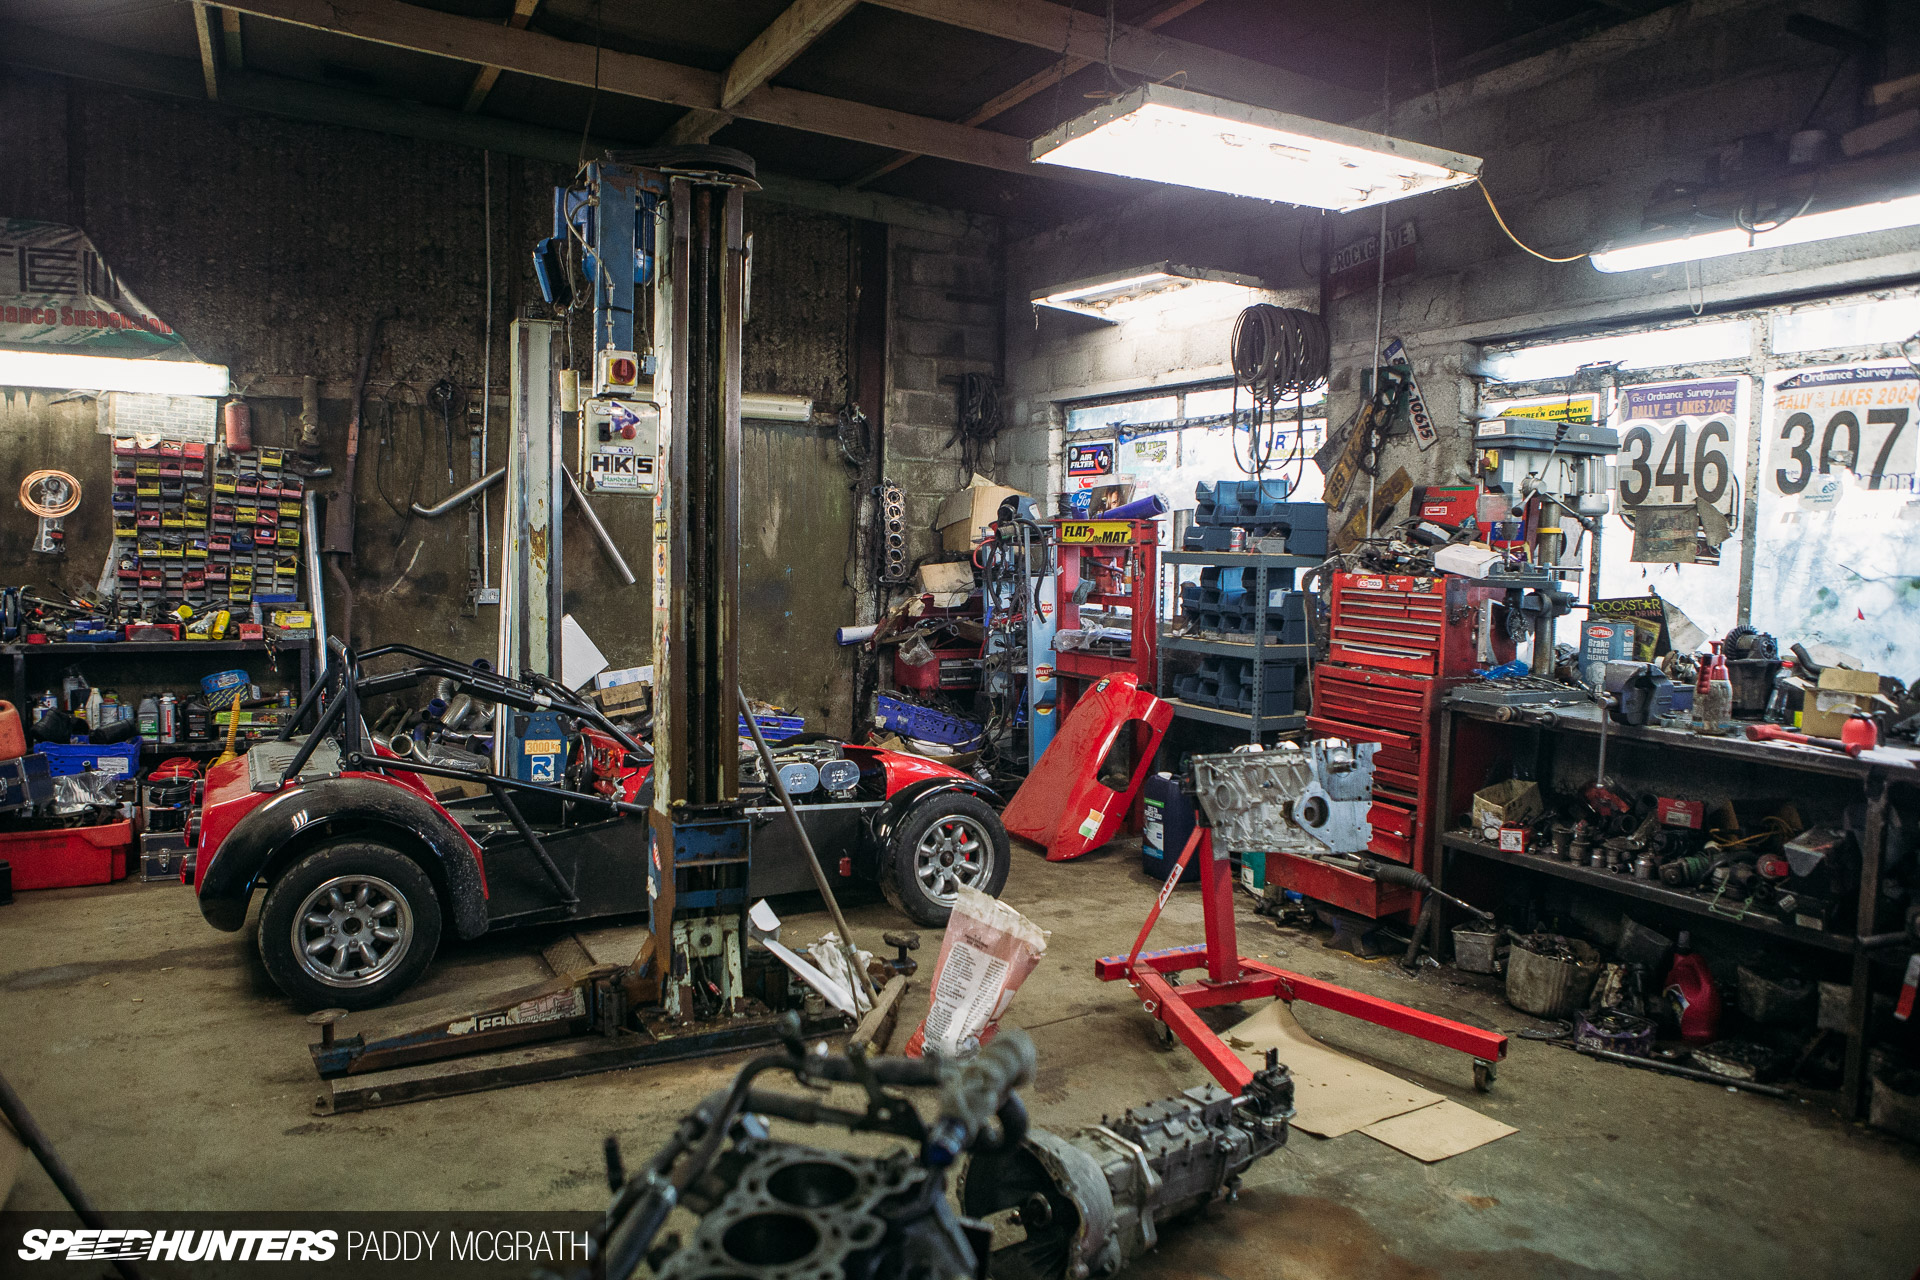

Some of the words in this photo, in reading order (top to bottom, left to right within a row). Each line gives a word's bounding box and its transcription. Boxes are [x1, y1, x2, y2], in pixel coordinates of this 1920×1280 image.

[0, 306, 57, 326] ance
[1802, 370, 1853, 383] Ordnance
[1855, 367, 1893, 379] Survey
[1647, 391, 1684, 402] Ordnance
[1686, 388, 1715, 399] Survey
[1777, 393, 1814, 410] RALLY
[1830, 388, 1873, 407] LAKES
[1876, 385, 1918, 405] 2004
[1631, 404, 1660, 418] RALLY
[1676, 400, 1706, 415] LAKES
[1706, 398, 1733, 413] 2005
[1079, 453, 1093, 461] AIR
[1776, 407, 1910, 495] 307
[592, 456, 653, 474] HKS
[1070, 460, 1095, 469] FILTER
[1619, 421, 1729, 506] 346
[1063, 525, 1090, 537] FLAT
[1101, 531, 1128, 543] MAT
[1368, 579, 1382, 587] TOOLS
[1635, 609, 1663, 617] DRINK
[1588, 628, 1612, 636] CarPlan
[1588, 639, 1610, 648] Brake
[1592, 647, 1608, 655] parts
[527, 741, 550, 752] 3000
